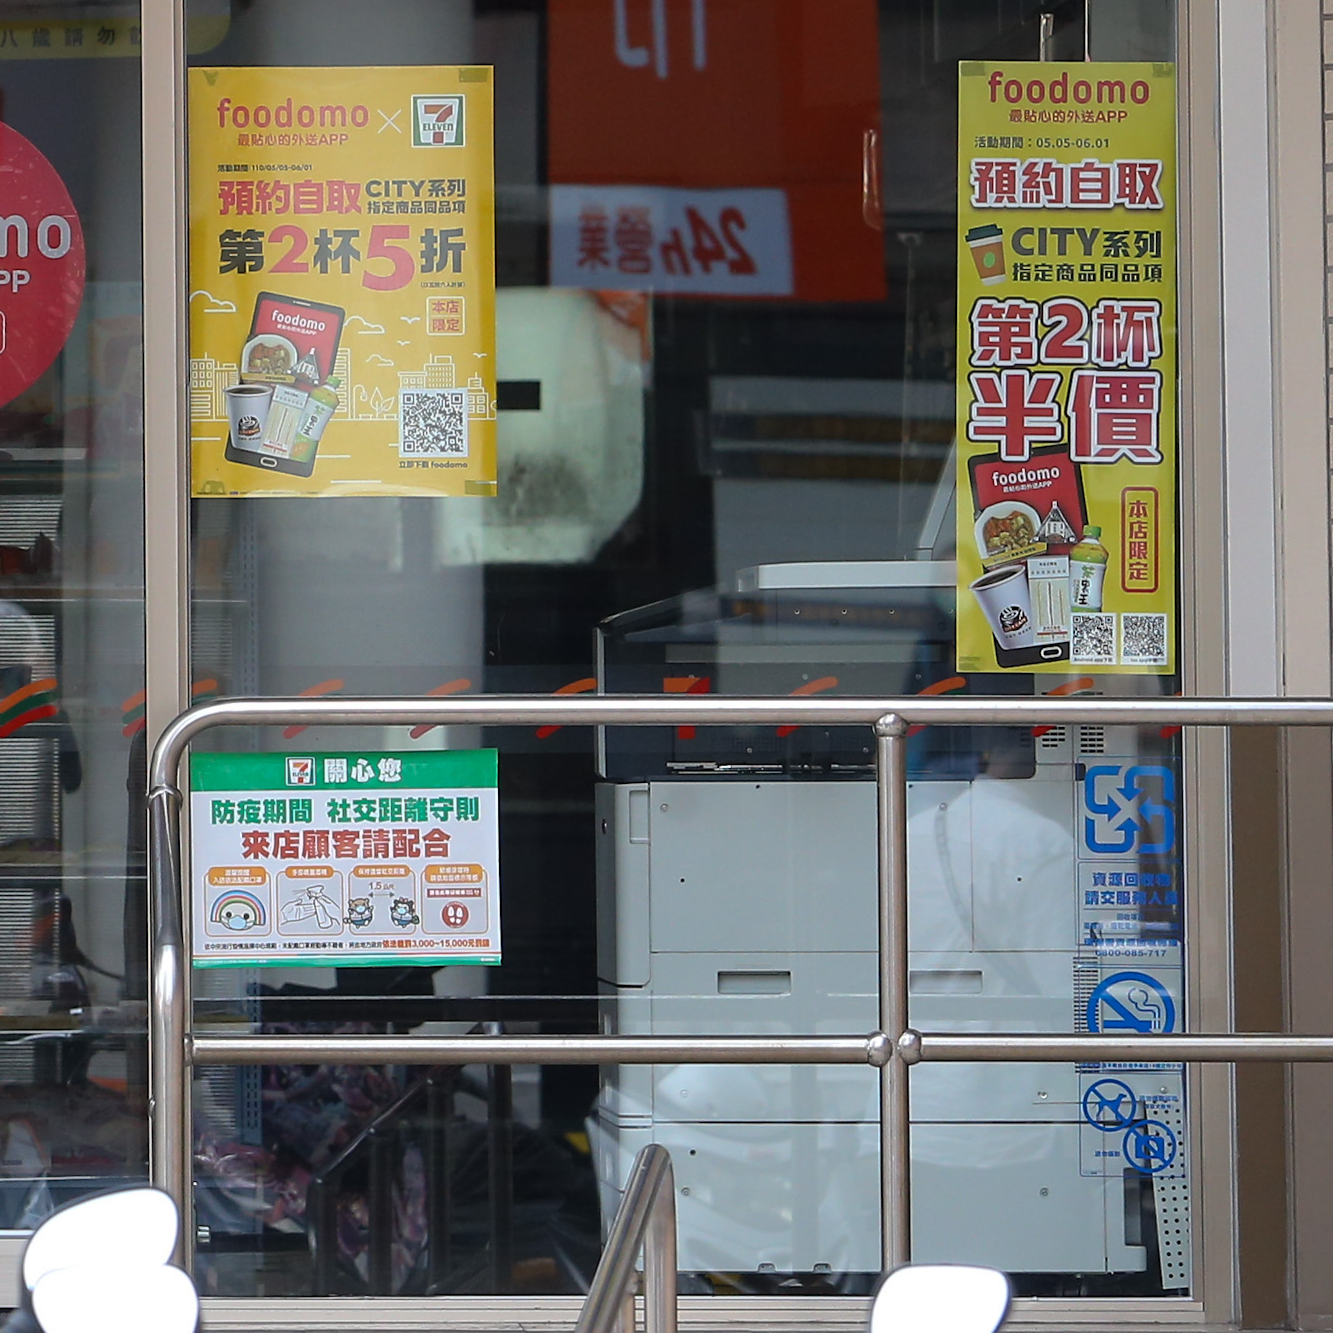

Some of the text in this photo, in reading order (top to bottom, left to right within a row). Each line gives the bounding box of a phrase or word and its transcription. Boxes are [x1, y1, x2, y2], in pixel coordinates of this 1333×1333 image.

[987, 70, 1150, 105] foodomo
[216, 98, 370, 129] foodomo
[1008, 110, 1128, 124] 最貼心的外送APP
[237, 133, 349, 147] 最貼心的外送APP
[217, 179, 362, 216] 預約自取
[364, 178, 466, 199] CITY系列
[971, 159, 1163, 208] 預約自取
[365, 200, 466, 215] 指定商品同品項
[218, 224, 467, 291] 第2杯5折
[1011, 226, 1162, 259] CITY系列
[1011, 262, 1163, 283] 指定商品同品項
[271, 308, 326, 332] foodomo
[431, 299, 460, 315] 本店
[431, 317, 461, 333] 限定
[971, 299, 1161, 366] 第2杯
[969, 370, 1163, 463] 半價
[430, 459, 468, 469] foodomo
[991, 466, 1061, 487] foodomo
[1128, 499, 1149, 581] 本店限定
[210, 795, 480, 826] 防疫期間 社交距離守則
[241, 827, 452, 861] 來店顧客請配合
